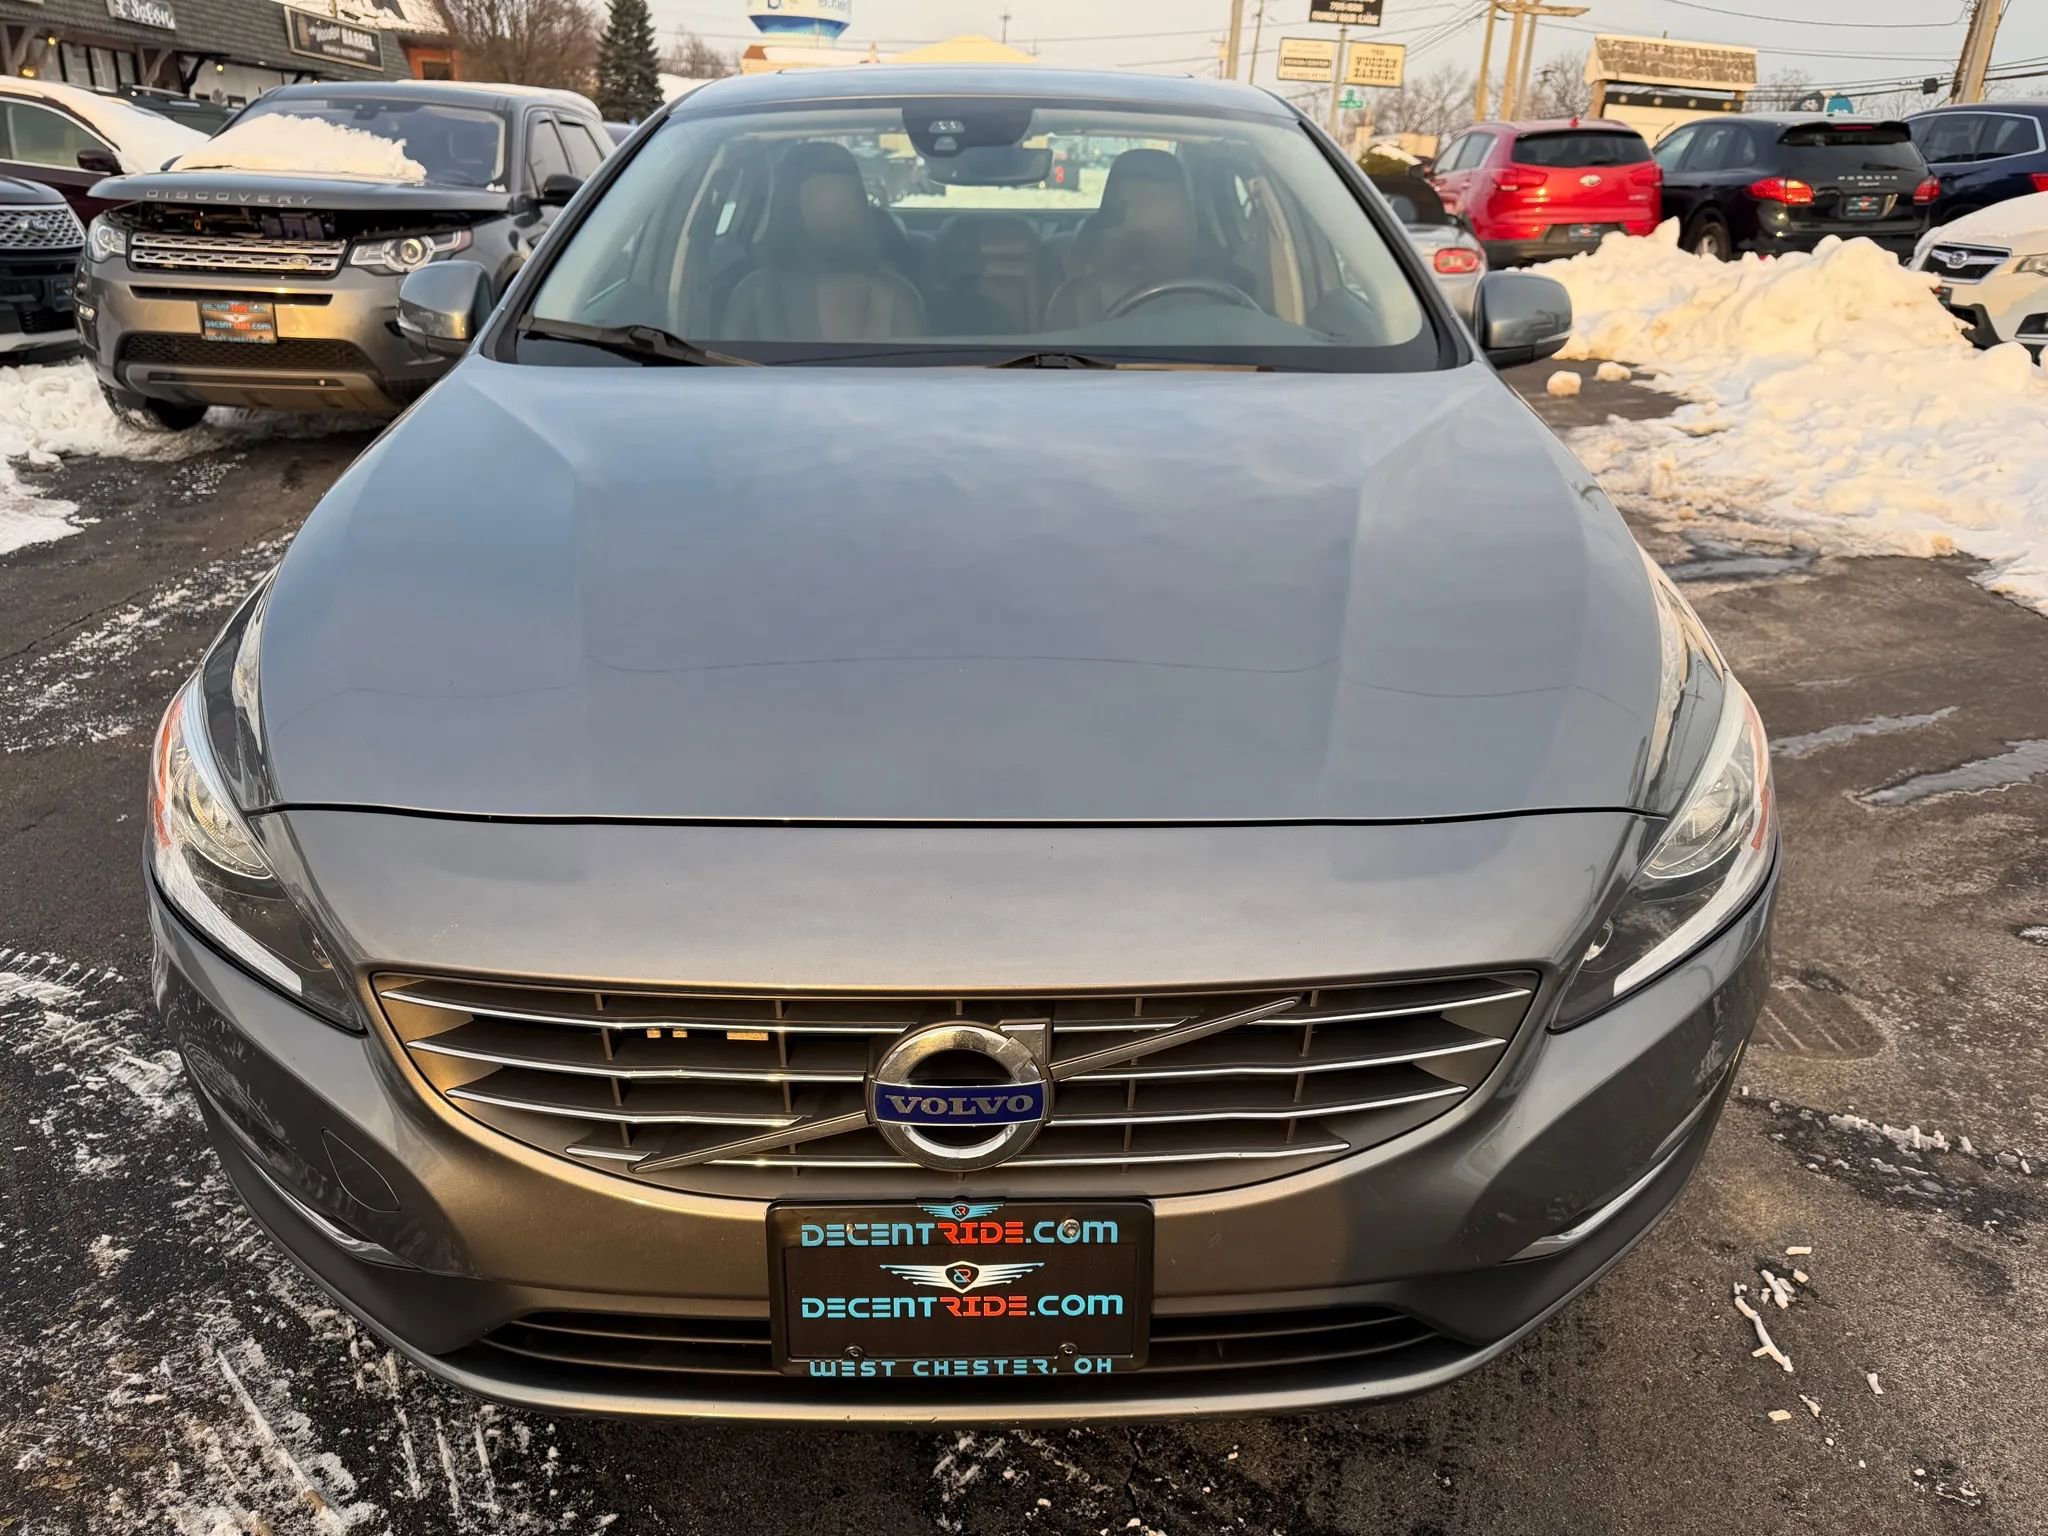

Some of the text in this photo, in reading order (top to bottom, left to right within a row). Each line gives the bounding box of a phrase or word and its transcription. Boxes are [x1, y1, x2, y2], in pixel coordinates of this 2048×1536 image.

[146, 189, 312, 205] DISCOVERY
[885, 1094, 1034, 1116] VOLVO
[809, 1357, 1113, 1377] WEST CHESTER, OH
